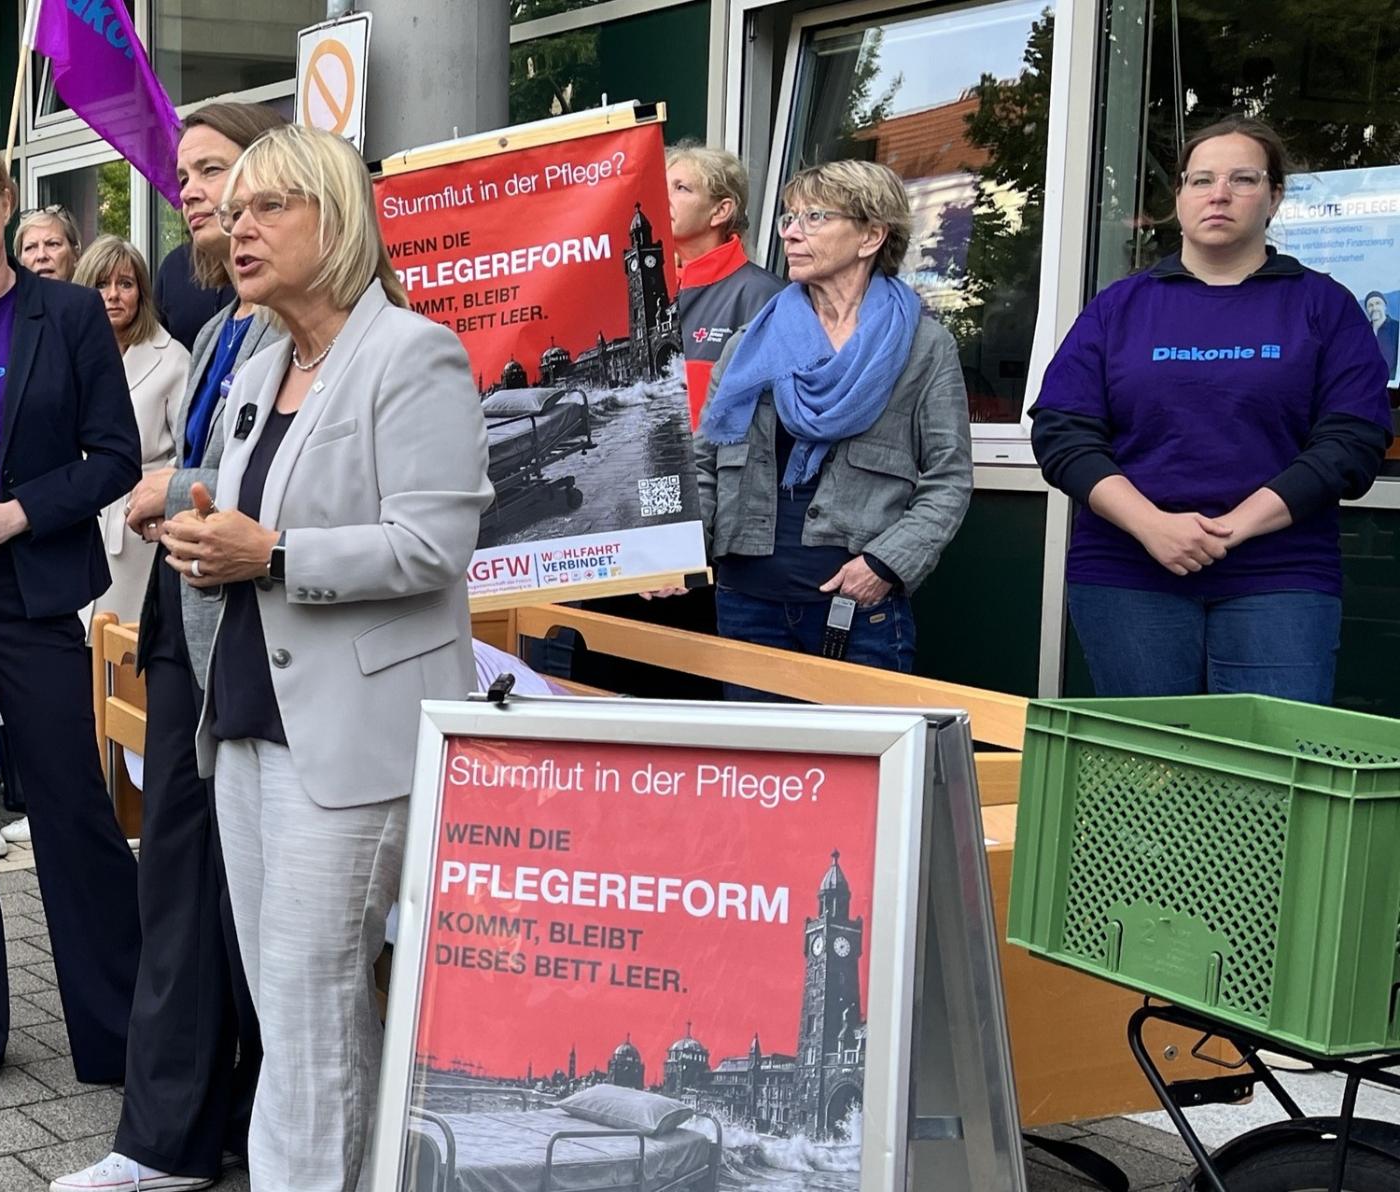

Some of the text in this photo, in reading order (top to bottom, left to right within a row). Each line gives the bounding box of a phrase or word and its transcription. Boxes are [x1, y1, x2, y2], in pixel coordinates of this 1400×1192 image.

[383, 151, 626, 219] Sturmflut in der Pflege?
[1346, 199, 1397, 215] PFLEGE
[387, 231, 471, 260] WENN DIE
[463, 286, 520, 309] BLEIBT
[456, 313, 497, 334] BETT
[501, 305, 549, 327] LEER.
[1152, 345, 1256, 361] Diakonie
[542, 555, 617, 573] VERBINDET.
[449, 756, 826, 809] Sturmflut in der Pflege?
[446, 821, 571, 851] WENN DIE
[440, 860, 790, 924] PFLEGEREFORM
[437, 910, 643, 951] KOMMT, BLEIBT
[436, 944, 689, 993] DIESES BETT LEER.
